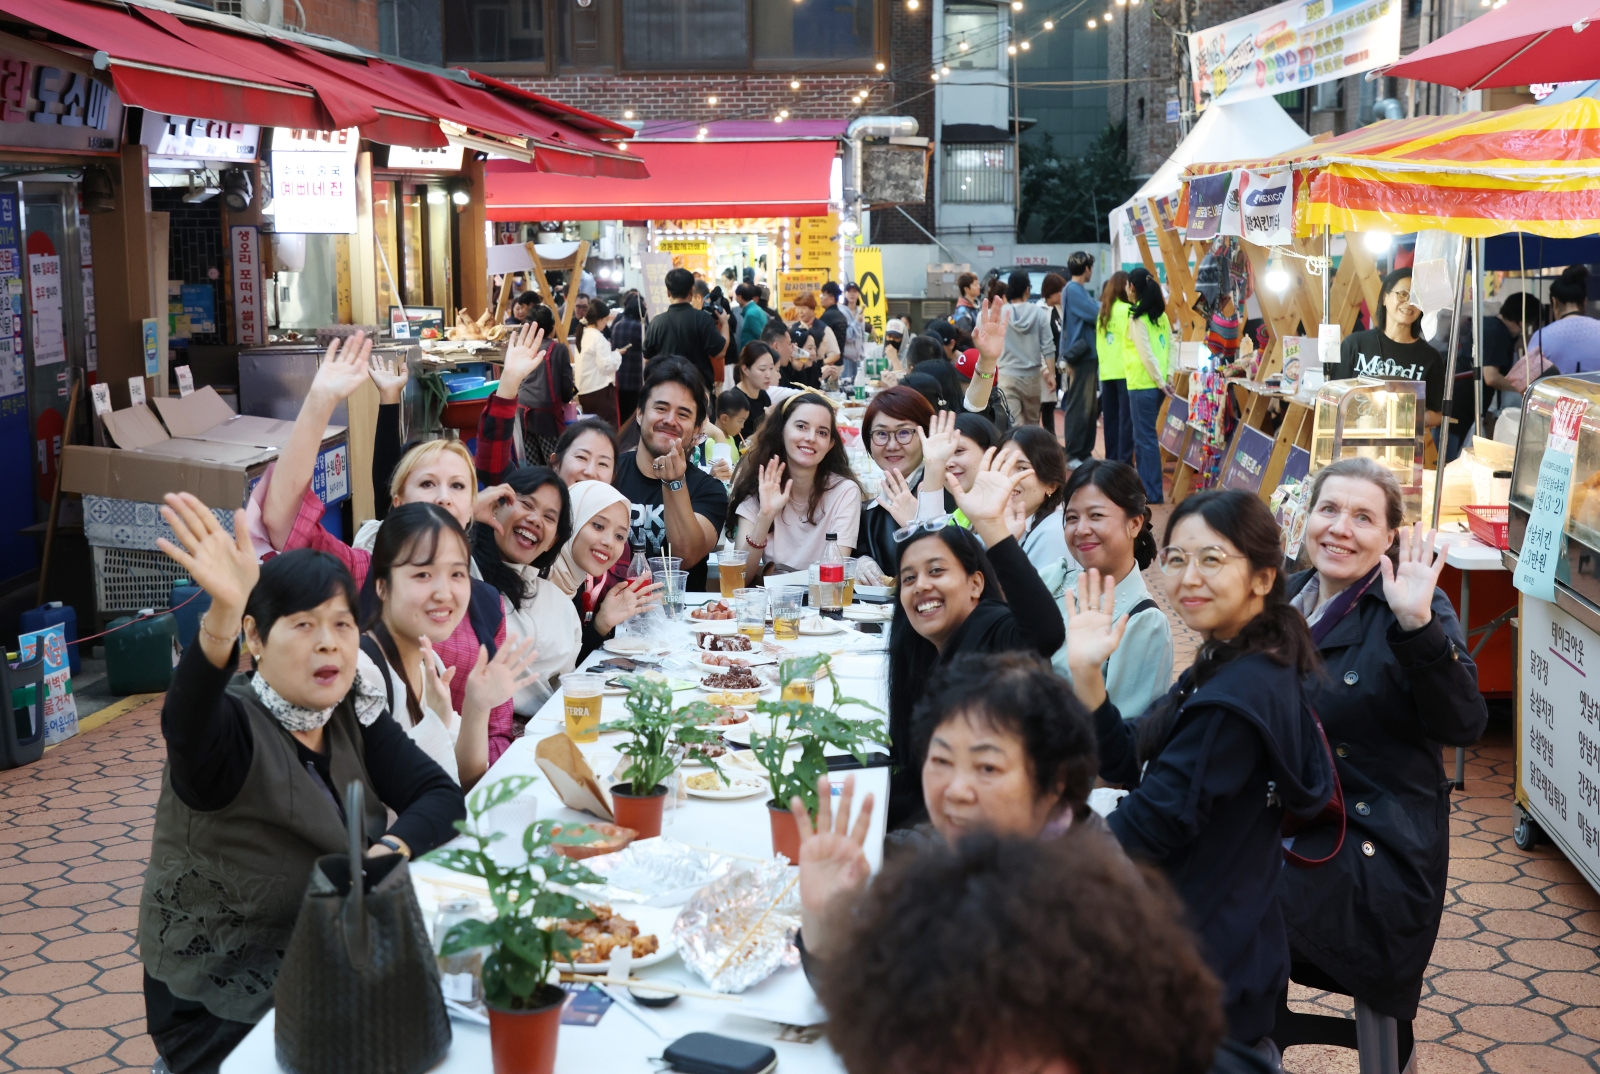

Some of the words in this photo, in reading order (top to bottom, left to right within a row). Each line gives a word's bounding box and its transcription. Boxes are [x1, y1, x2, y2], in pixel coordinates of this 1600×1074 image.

[1258, 192, 1284, 203] MEXICO
[238, 230, 251, 265] 생오리
[784, 282, 821, 291] 감사이벤트
[1354, 353, 1424, 381] Mardi
[1552, 621, 1585, 667] 테이크아웃
[1530, 649, 1549, 686] 닭강정
[566, 706, 590, 717] TERRA
[1530, 688, 1554, 730] 순살치킨
[1530, 725, 1554, 768] 순살양념
[1530, 760, 1567, 822] 닭모래집튀김
